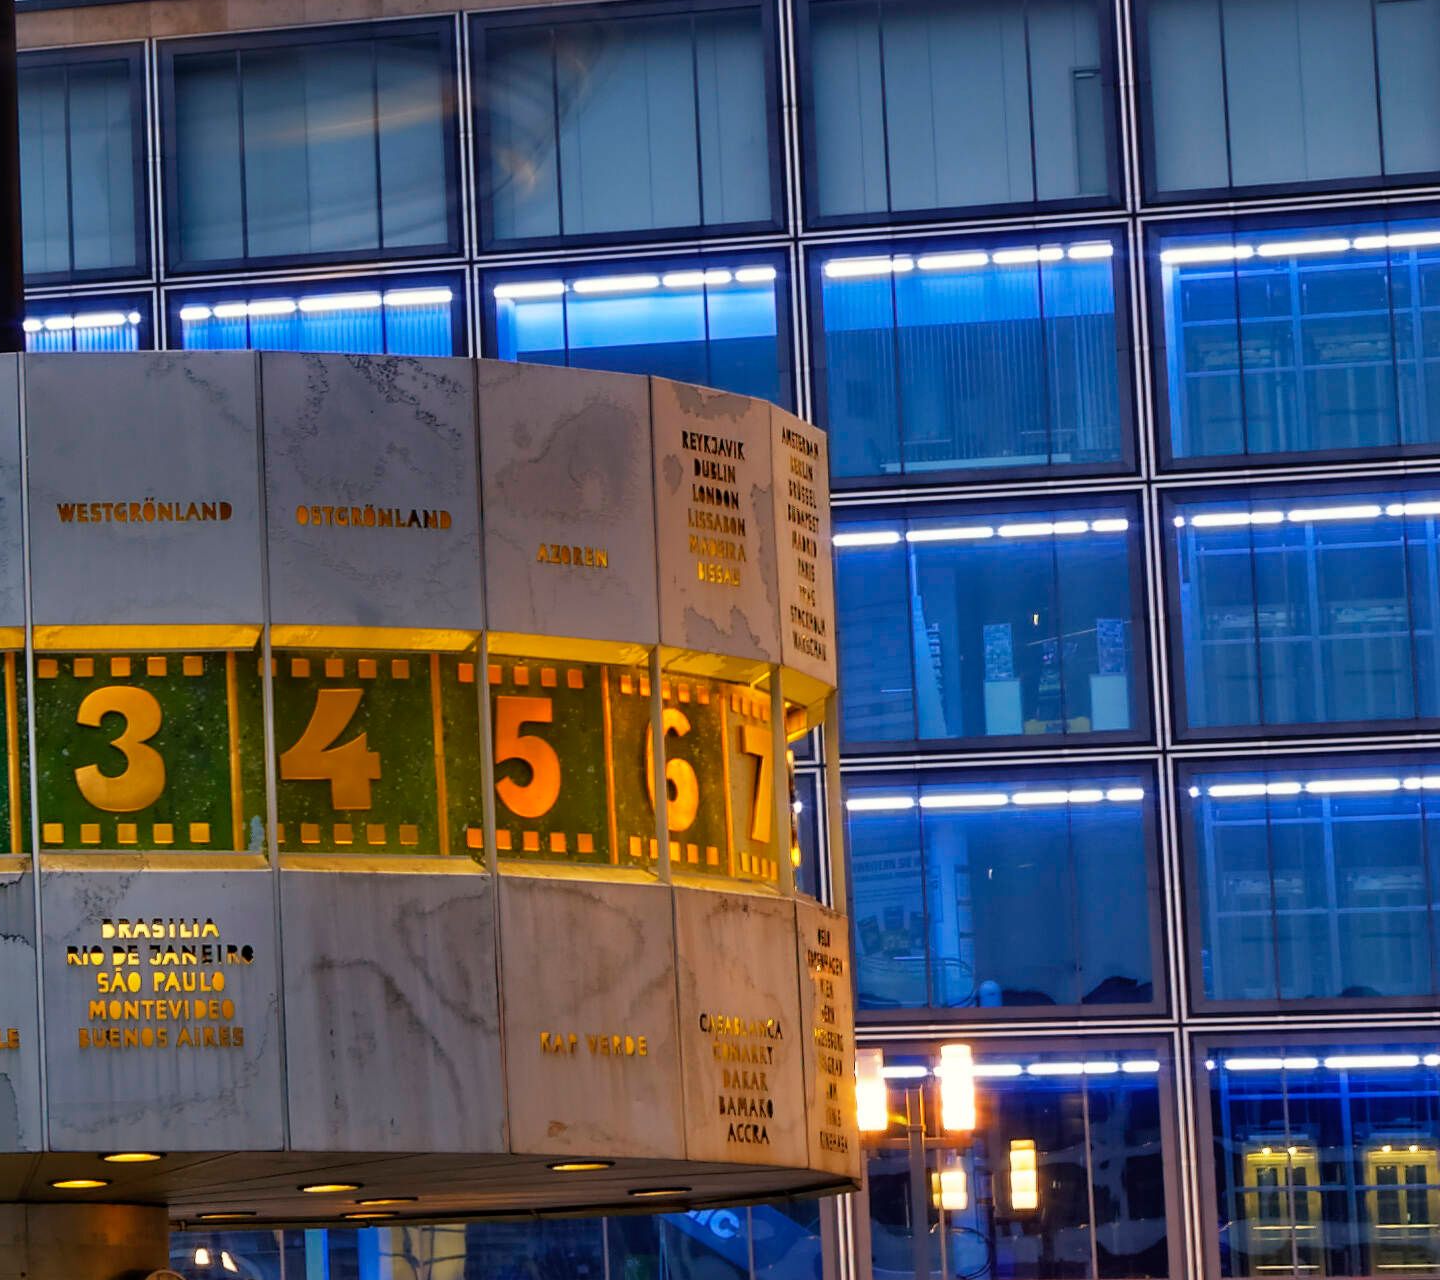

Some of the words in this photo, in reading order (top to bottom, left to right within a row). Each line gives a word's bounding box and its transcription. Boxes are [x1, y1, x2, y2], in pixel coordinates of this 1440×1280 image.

[682, 431, 745, 460] REYKJAVIK
[694, 458, 736, 483] DUBLIN
[692, 484, 739, 509] LONDON
[57, 497, 233, 523] WESTGRÖNLAND
[296, 504, 453, 530] OSTGRÖNLAND
[688, 508, 746, 536] LISSABON
[537, 543, 608, 568] AZOREN
[697, 560, 740, 587] BISSAU
[74, 686, 166, 811] 3
[280, 689, 381, 809] 4
[495, 696, 562, 818] 5
[645, 708, 700, 832] 6
[741, 725, 773, 841] 7
[102, 918, 220, 939] BRASILIA
[67, 945, 105, 966] RIO
[112, 945, 140, 966] DE
[149, 945, 254, 966] JANEIRO
[96, 966, 142, 993] SÃO
[153, 971, 225, 993] PAULO
[88, 999, 235, 1021] MONTEVIDEO
[78, 1027, 169, 1049] BUENOS
[176, 1027, 245, 1049] AIRES
[699, 1013, 783, 1041] CASABLANCA
[540, 1031, 577, 1056] KAP
[586, 1033, 648, 1057] VERDE
[723, 1068, 769, 1092] DAKAR
[719, 1096, 774, 1119] BAMAKO
[728, 1123, 770, 1144] ACCRA
